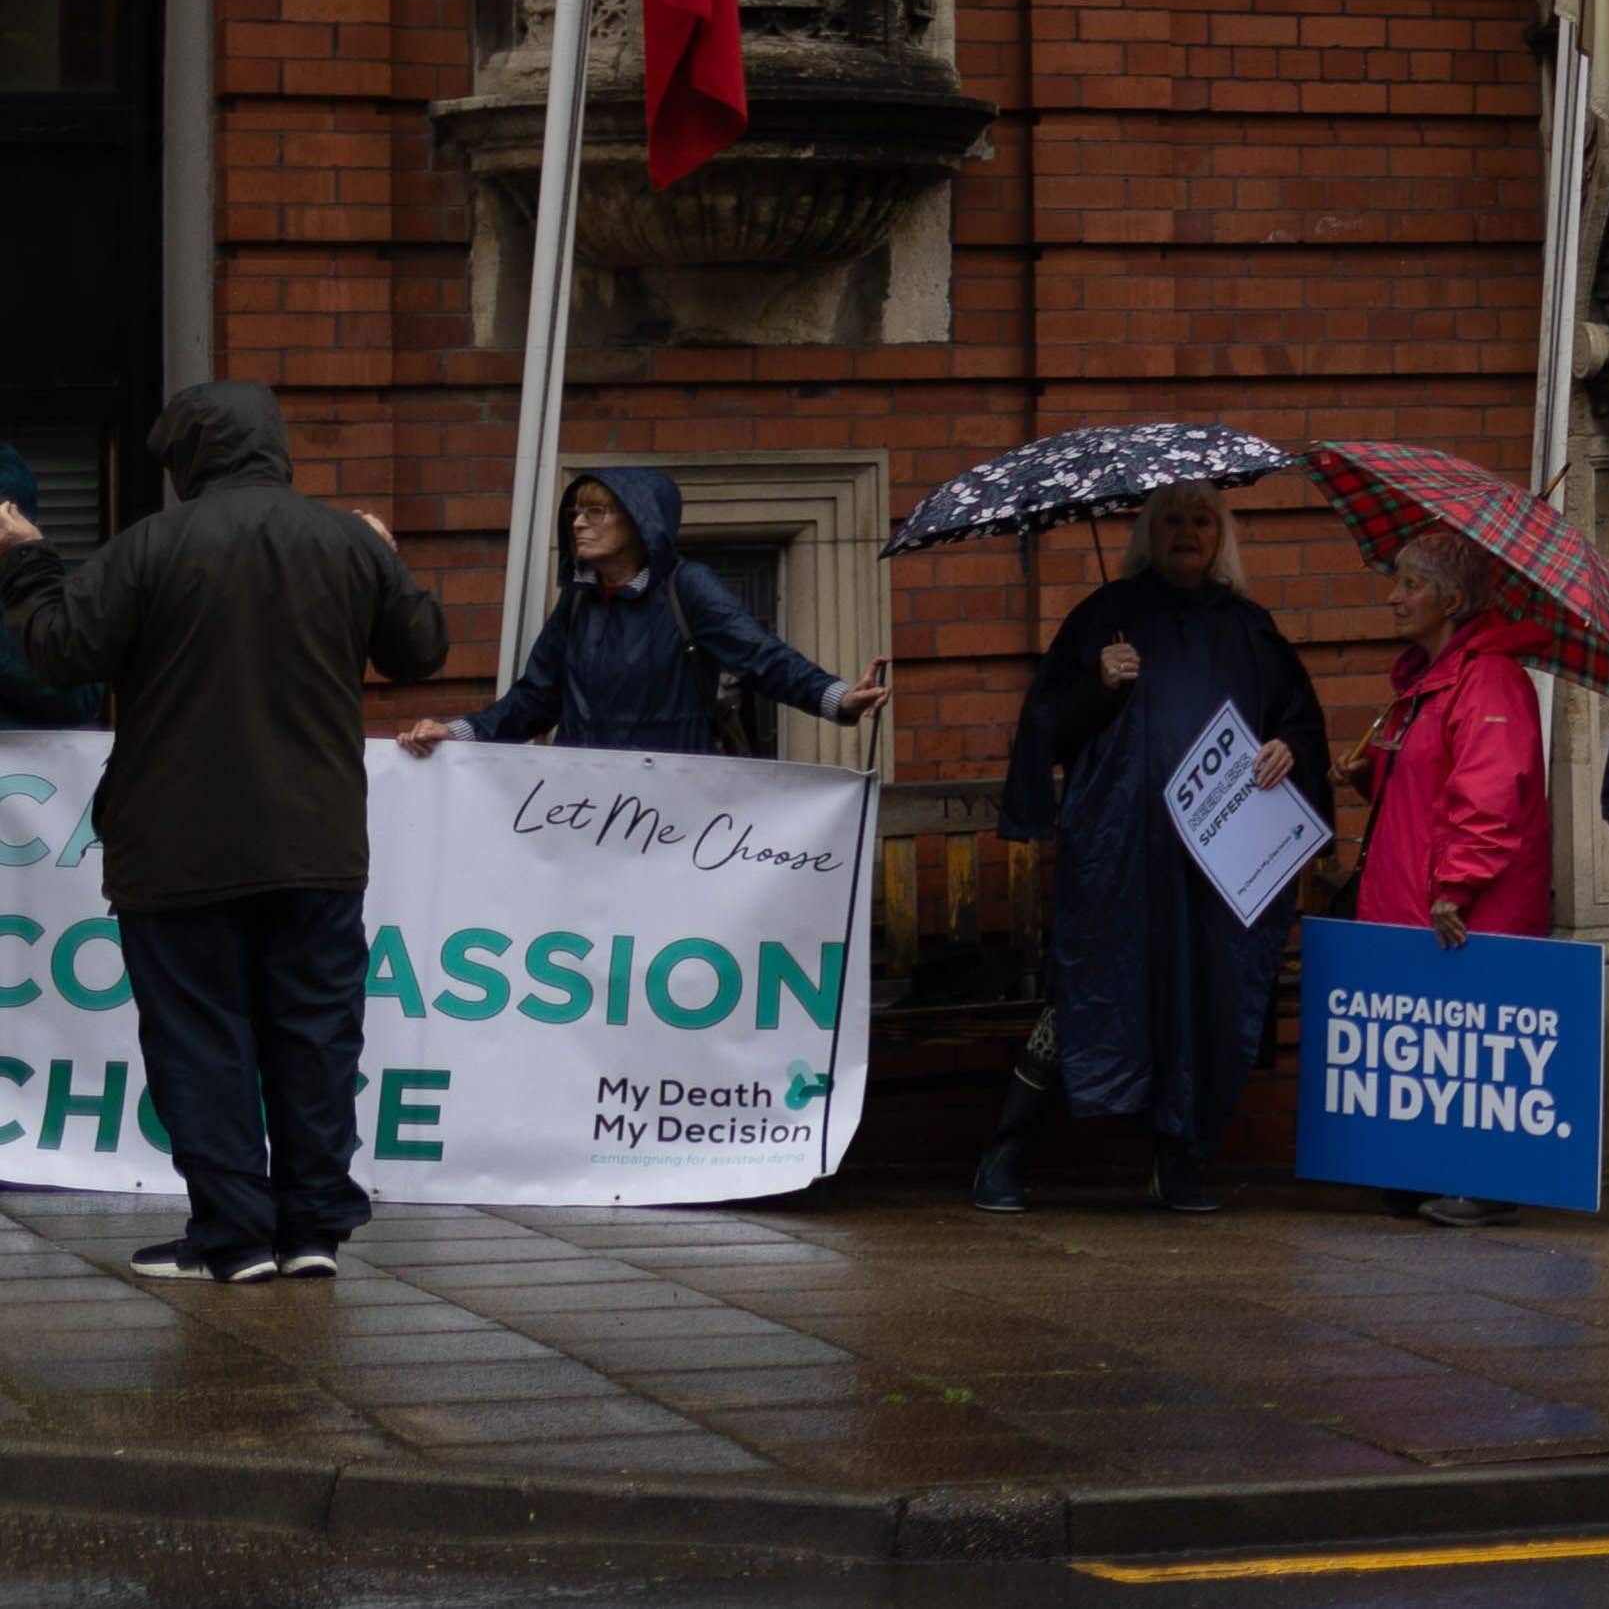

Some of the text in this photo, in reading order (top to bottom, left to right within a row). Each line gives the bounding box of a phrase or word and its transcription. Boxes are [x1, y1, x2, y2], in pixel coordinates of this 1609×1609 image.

[1176, 728, 1235, 811] STOP
[513, 780, 844, 872] Let Me Choose
[1199, 774, 1260, 846] SUFFERIN
[1328, 988, 1559, 1037] CAMPAIGN FOR
[1326, 1018, 1559, 1086] DIGNITY
[597, 1077, 772, 1111] My Death
[1325, 1068, 1572, 1138] IN DYING.
[593, 1114, 812, 1148] My Decision
